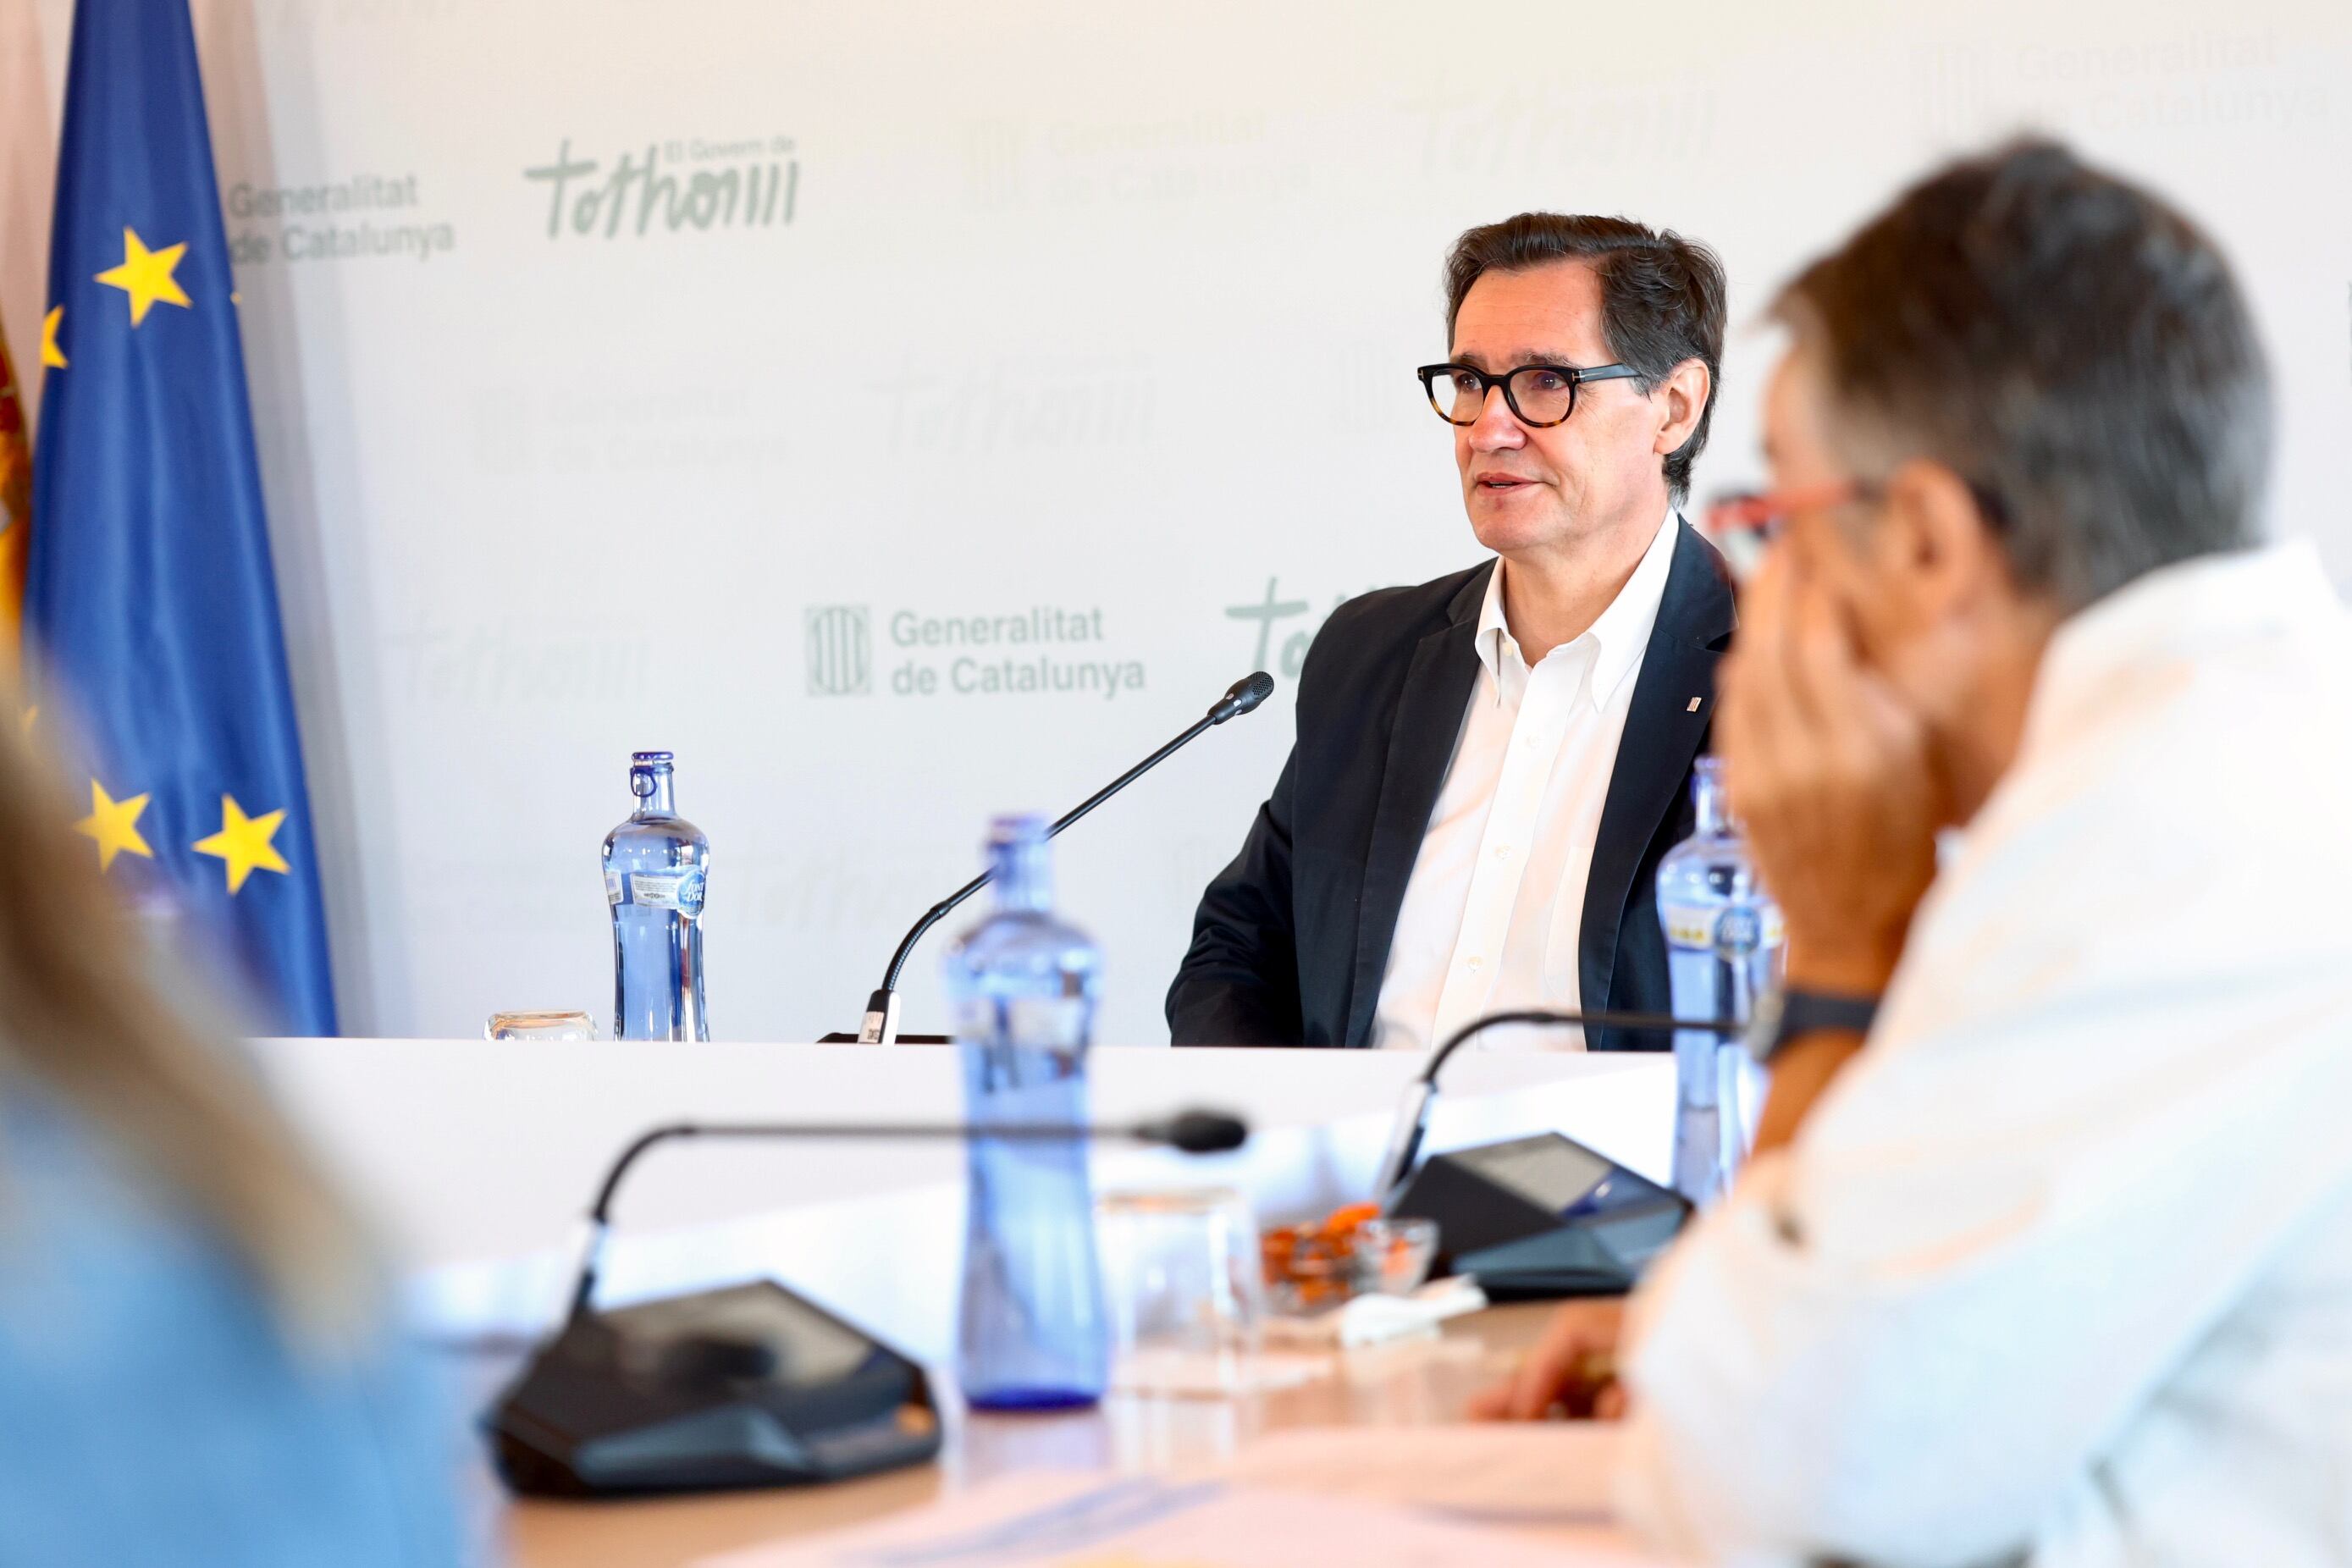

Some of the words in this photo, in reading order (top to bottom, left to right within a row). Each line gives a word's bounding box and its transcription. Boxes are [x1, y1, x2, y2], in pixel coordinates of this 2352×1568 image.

[689, 137, 765, 162] Govern
[229, 170, 419, 219] Generalitat
[280, 219, 455, 264] Catalunya
[890, 604, 1105, 649] Generalitat
[891, 658, 938, 697] de
[950, 654, 1146, 702] Catalunya
